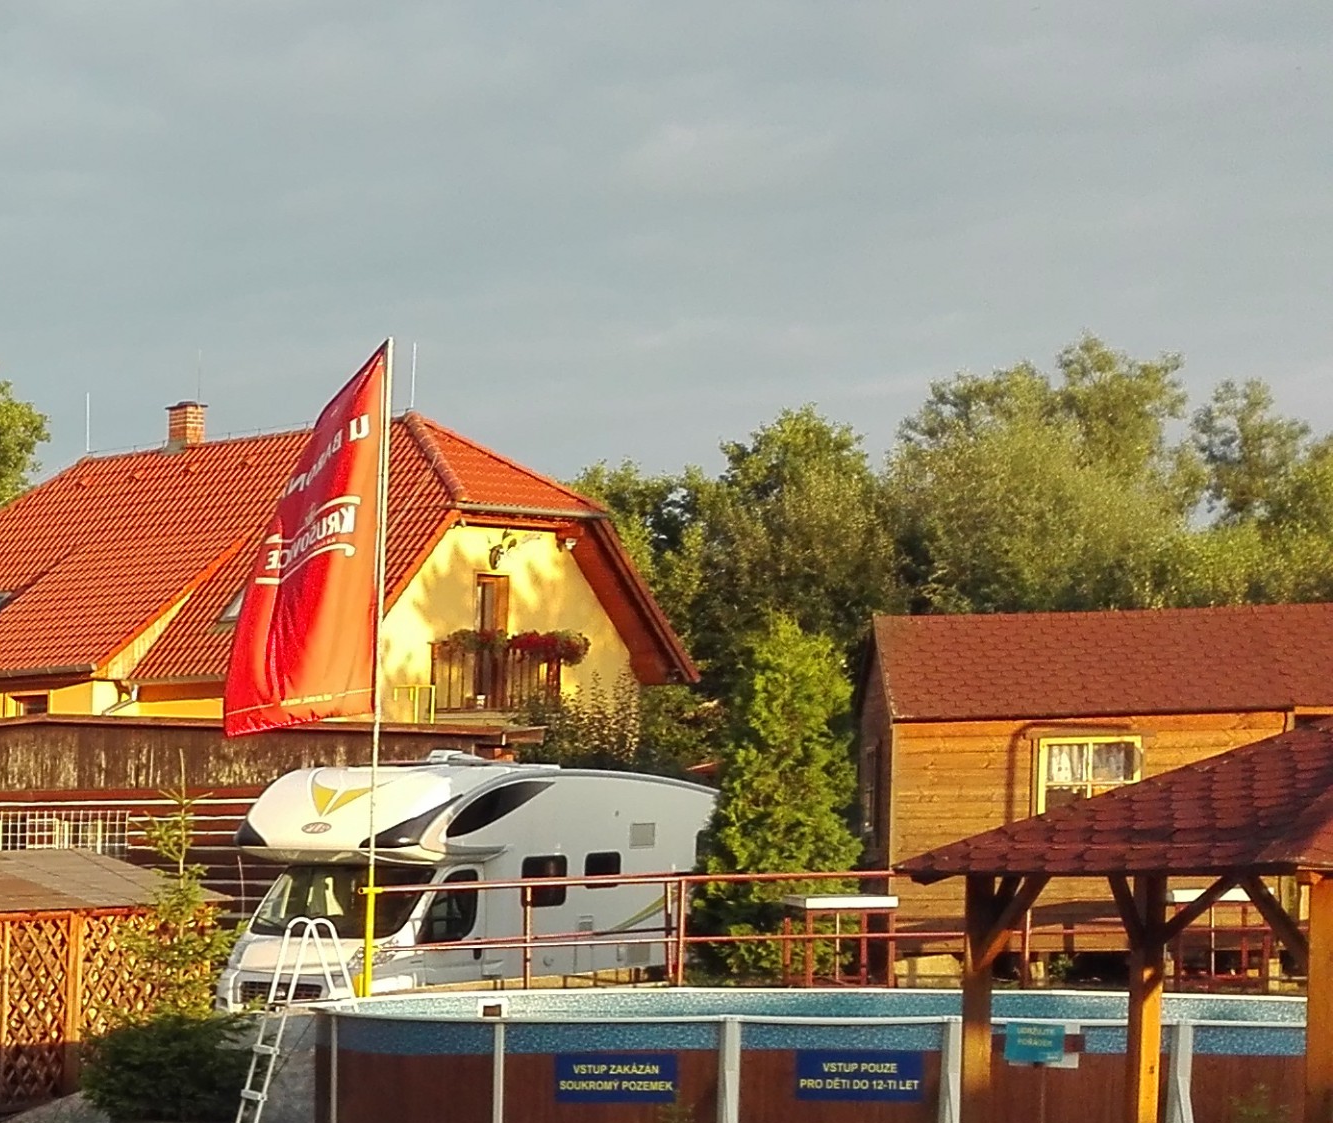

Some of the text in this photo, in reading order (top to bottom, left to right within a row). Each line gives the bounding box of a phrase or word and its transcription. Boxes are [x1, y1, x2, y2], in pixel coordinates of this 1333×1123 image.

[573, 1062, 660, 1075] VSTUP ZAKÁZÁN
[822, 1062, 898, 1074] VSTUP POUZE
[559, 1079, 673, 1091] SOUKROMÝ POZEMEK
[799, 1077, 920, 1090] PRO DĚTI DO 12-TI LET
